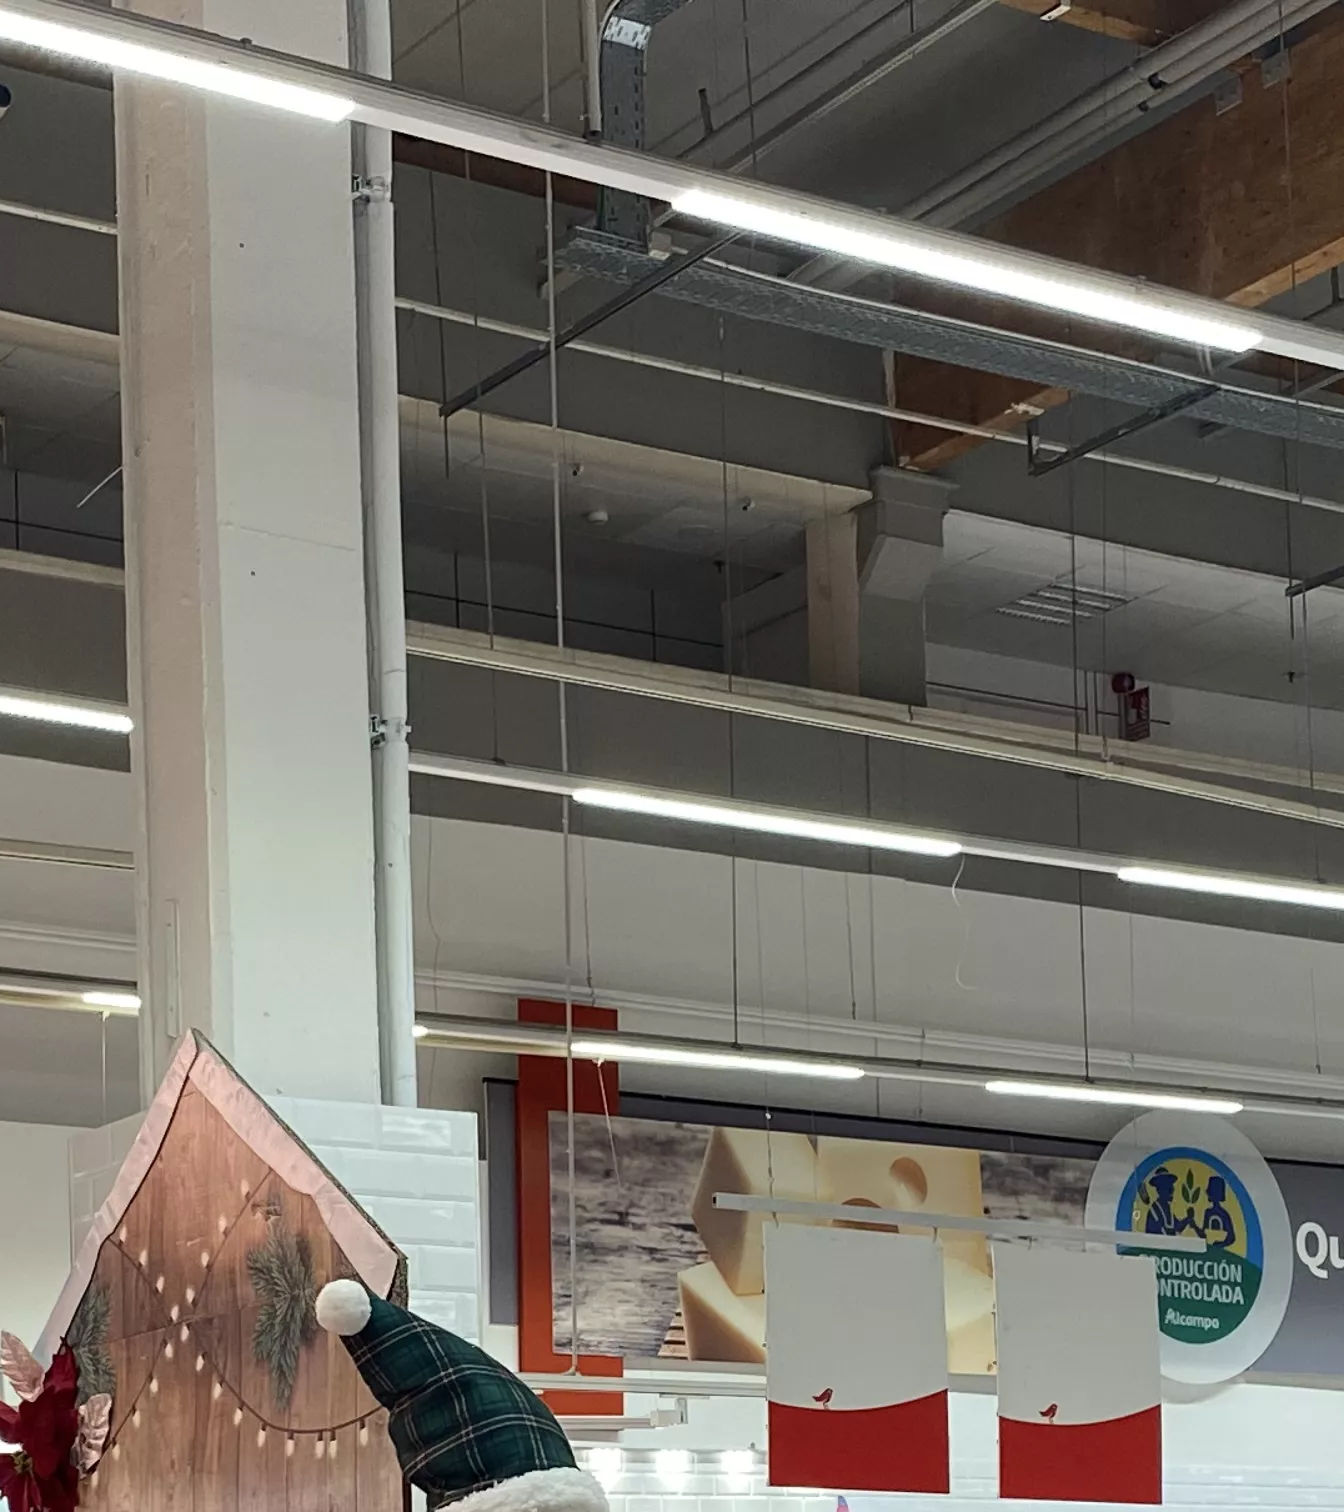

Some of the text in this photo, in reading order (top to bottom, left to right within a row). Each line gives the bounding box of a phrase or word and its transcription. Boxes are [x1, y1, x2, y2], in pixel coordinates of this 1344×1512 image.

[1154, 1256, 1243, 1283] RODUCCIÓN
[1157, 1278, 1245, 1305] NTROLADA
[1164, 1308, 1220, 1331] Alcampo
